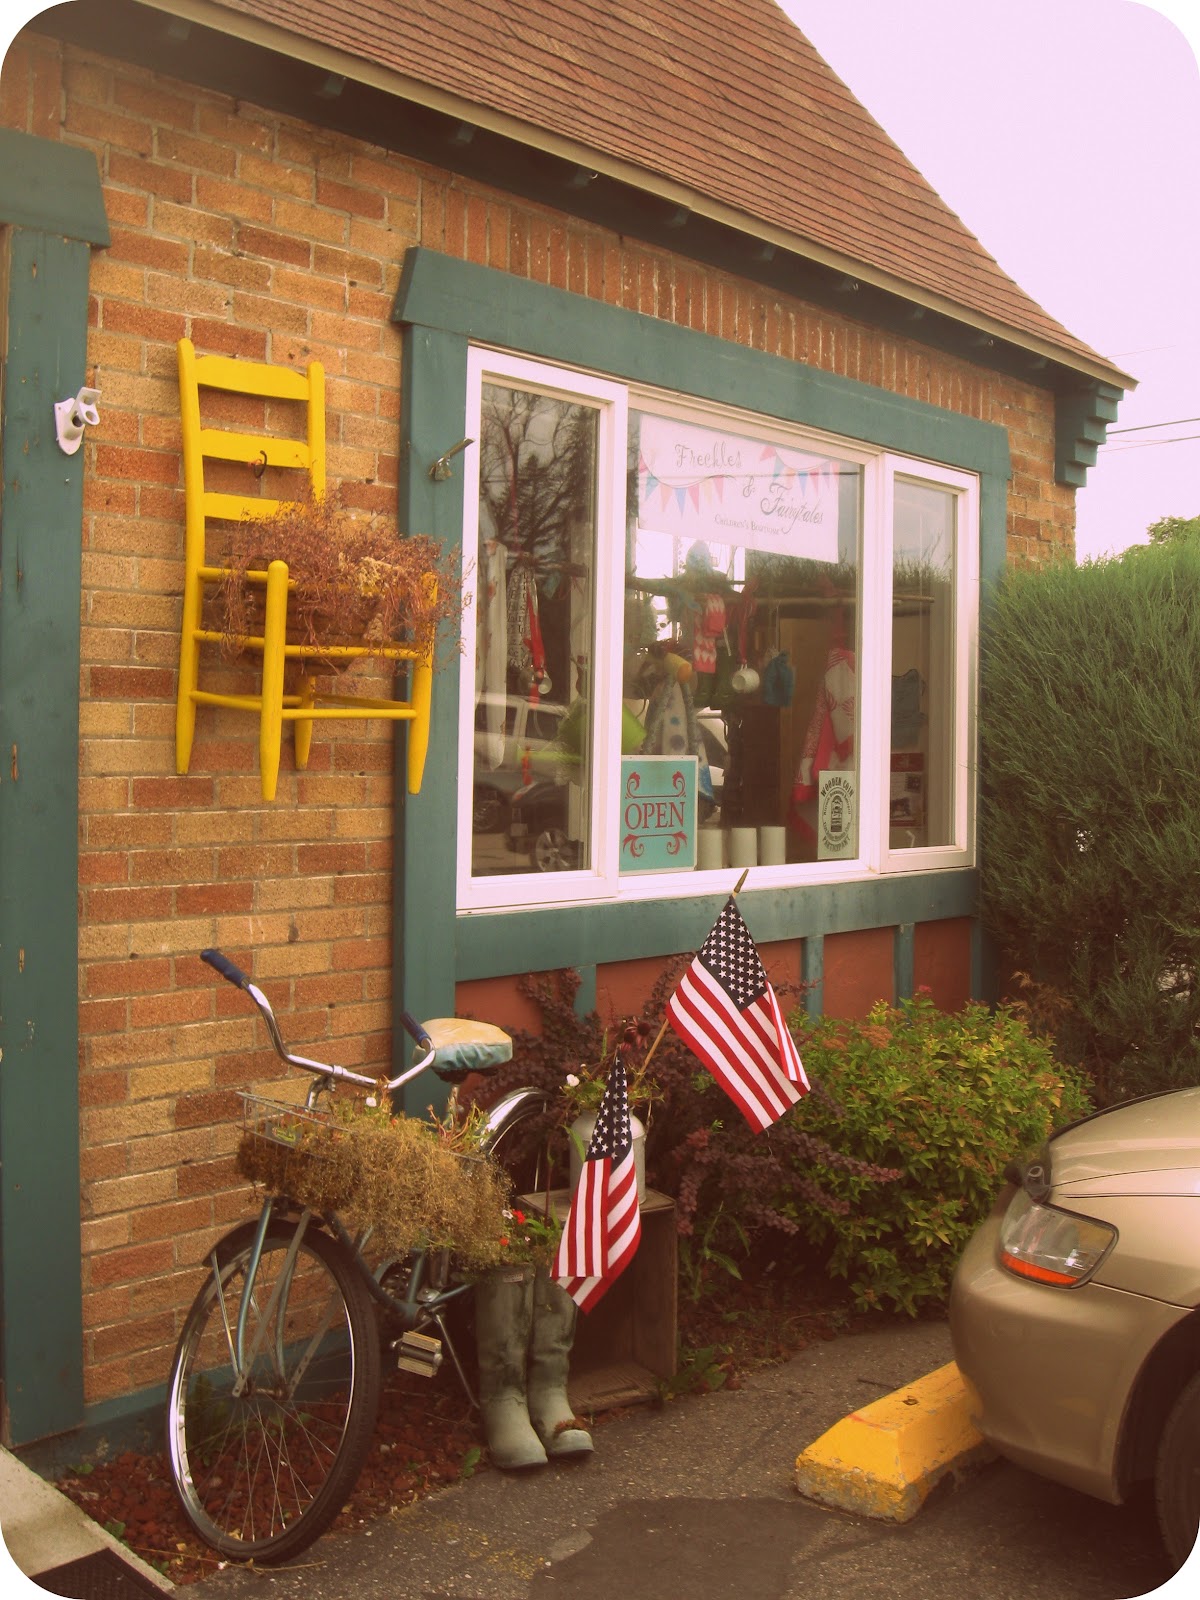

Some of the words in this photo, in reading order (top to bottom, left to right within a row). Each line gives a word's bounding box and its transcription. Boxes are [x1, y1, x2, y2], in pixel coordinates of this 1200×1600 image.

[674, 441, 742, 468] Freckles
[742, 475, 756, 498] &
[760, 481, 824, 534] Fairytales
[624, 801, 686, 830] OPEN
